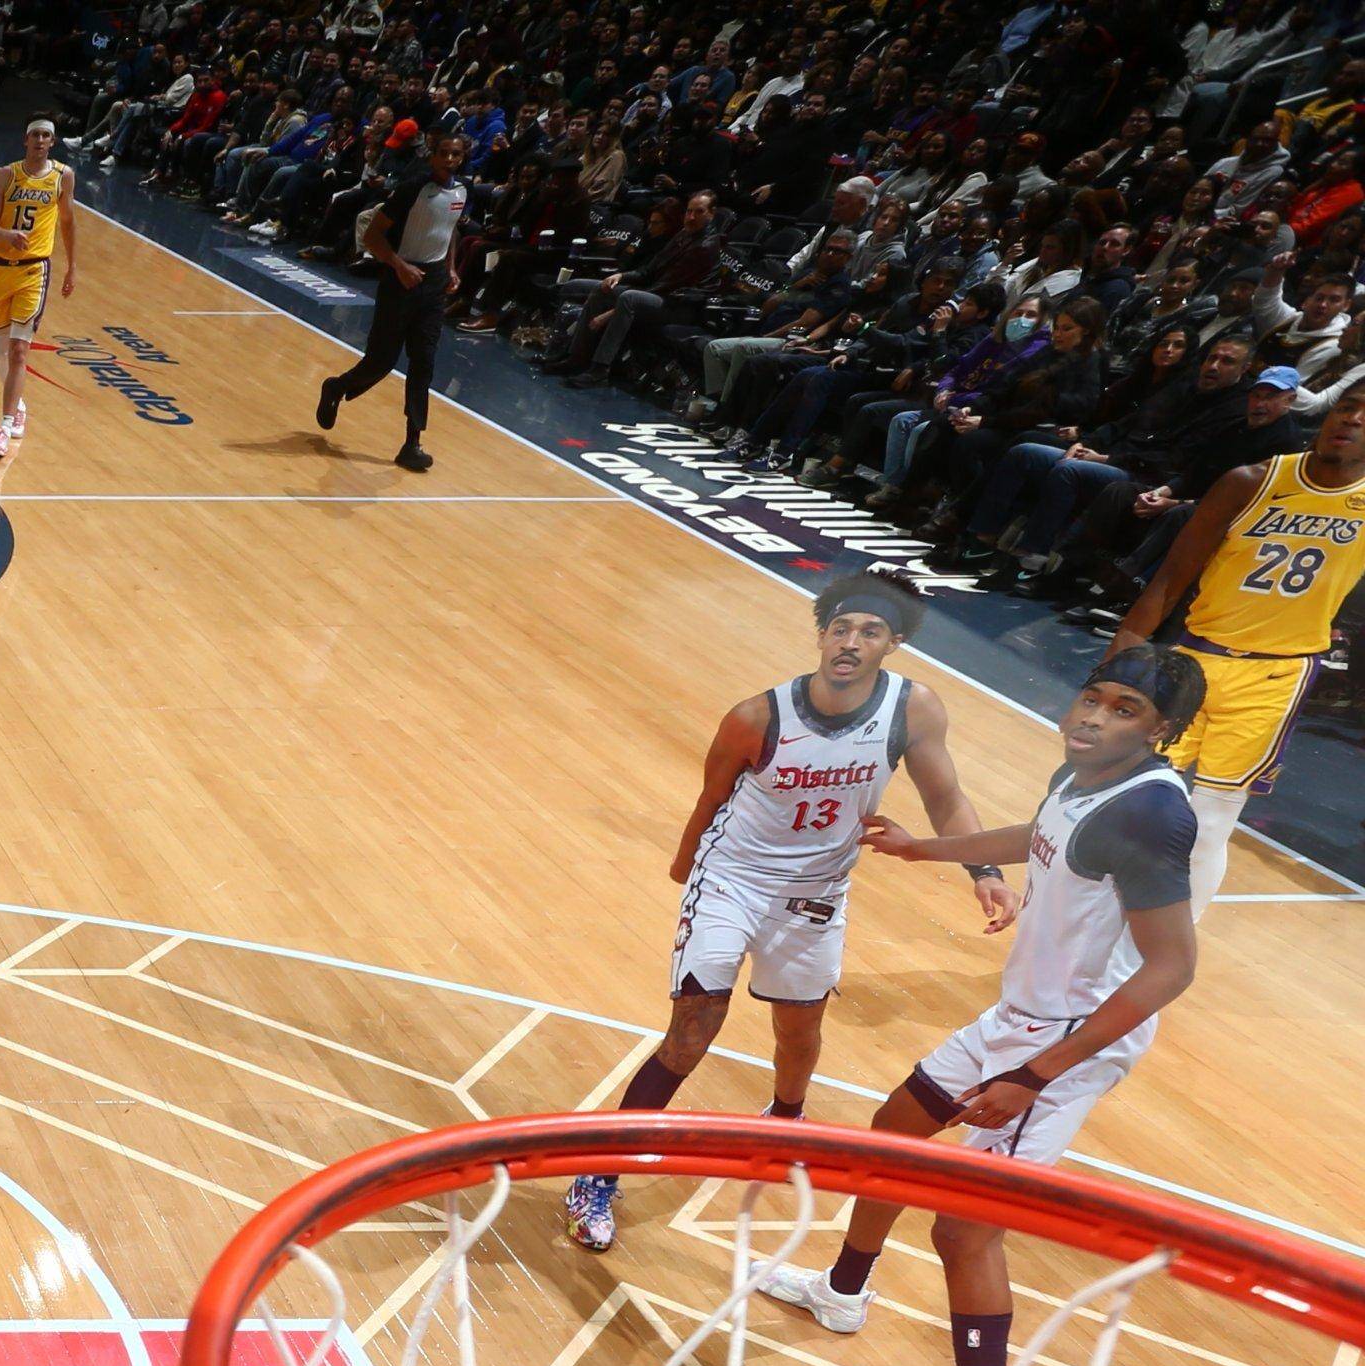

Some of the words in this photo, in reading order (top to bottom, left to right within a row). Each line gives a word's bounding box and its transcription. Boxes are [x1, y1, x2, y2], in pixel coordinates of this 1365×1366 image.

[7, 186, 54, 205] LAKERS
[12, 204, 38, 232] 15
[102, 326, 180, 365] Arena
[579, 451, 807, 553] BEYOND
[1241, 506, 1364, 545] LAKERS
[1239, 541, 1326, 598] 28
[772, 760, 879, 791] District
[791, 798, 842, 832] 13
